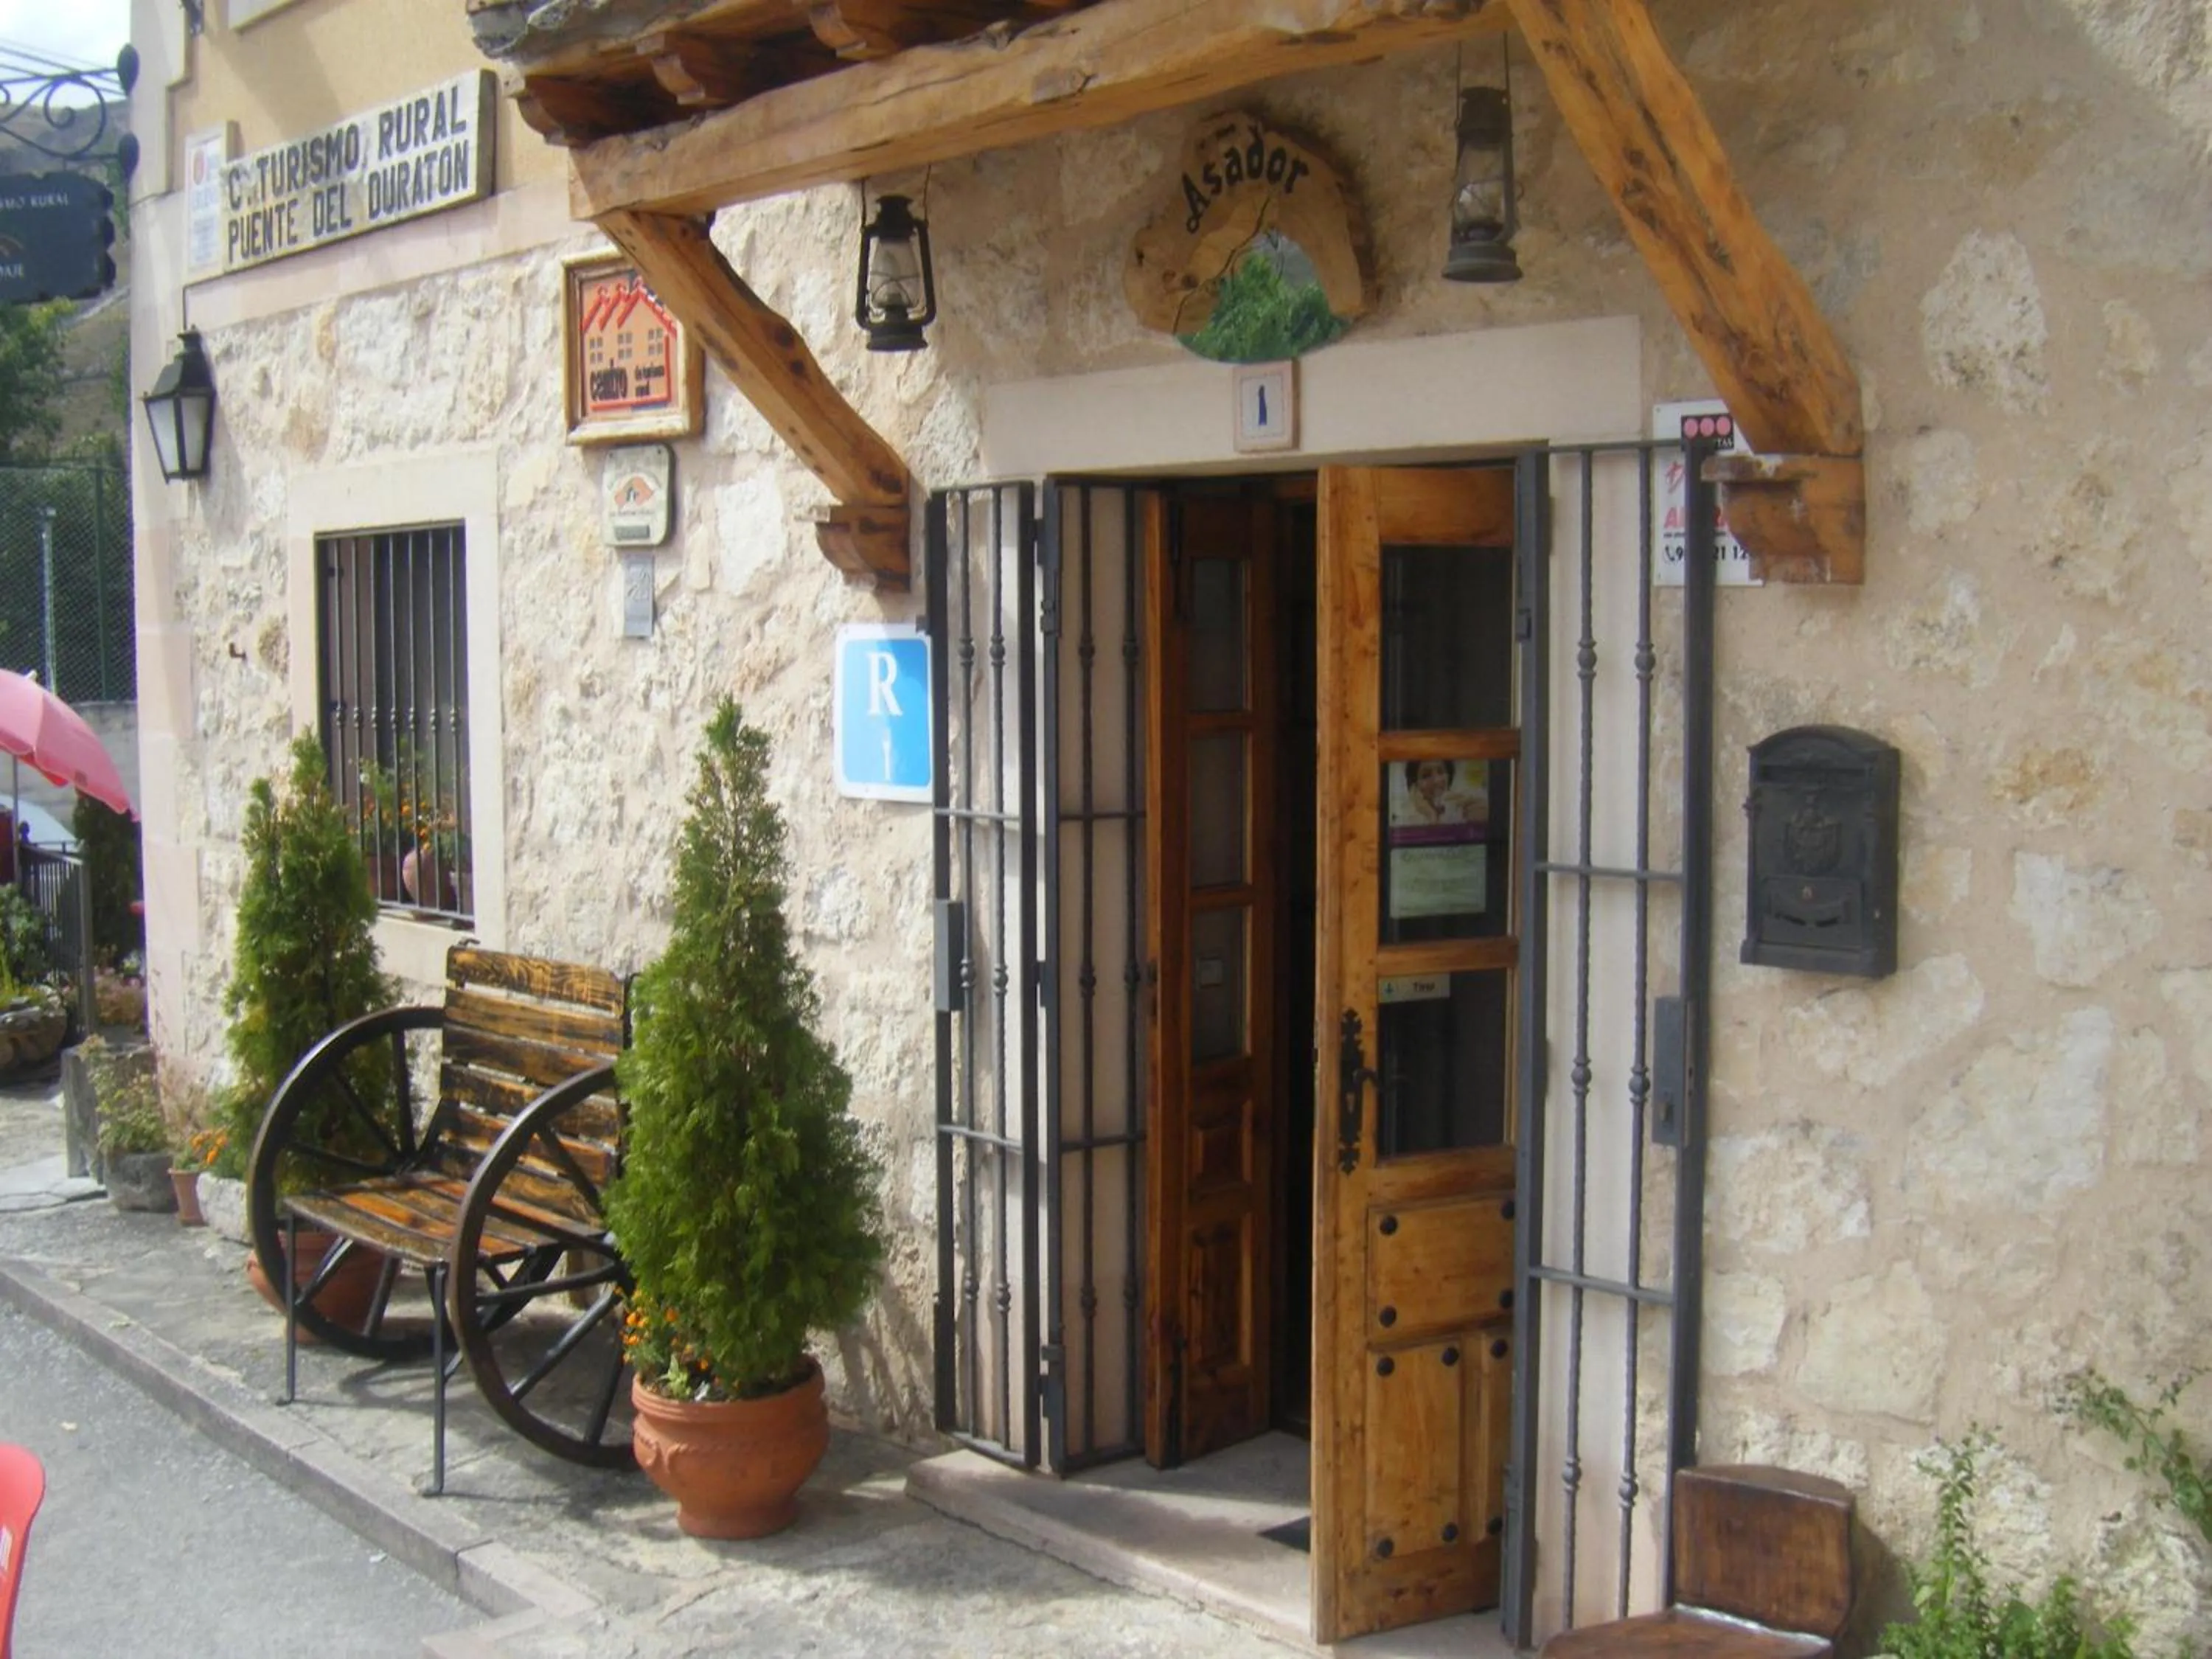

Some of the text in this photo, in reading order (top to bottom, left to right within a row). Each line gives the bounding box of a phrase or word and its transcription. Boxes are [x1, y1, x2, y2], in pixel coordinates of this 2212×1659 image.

[228, 198, 298, 264] PUENTE
[313, 182, 352, 238] DEL
[368, 139, 470, 220] DURATON
[256, 123, 360, 203] TURISMO
[378, 86, 467, 161] RURAL
[1182, 121, 1310, 234] Asador
[866, 651, 903, 717] R
